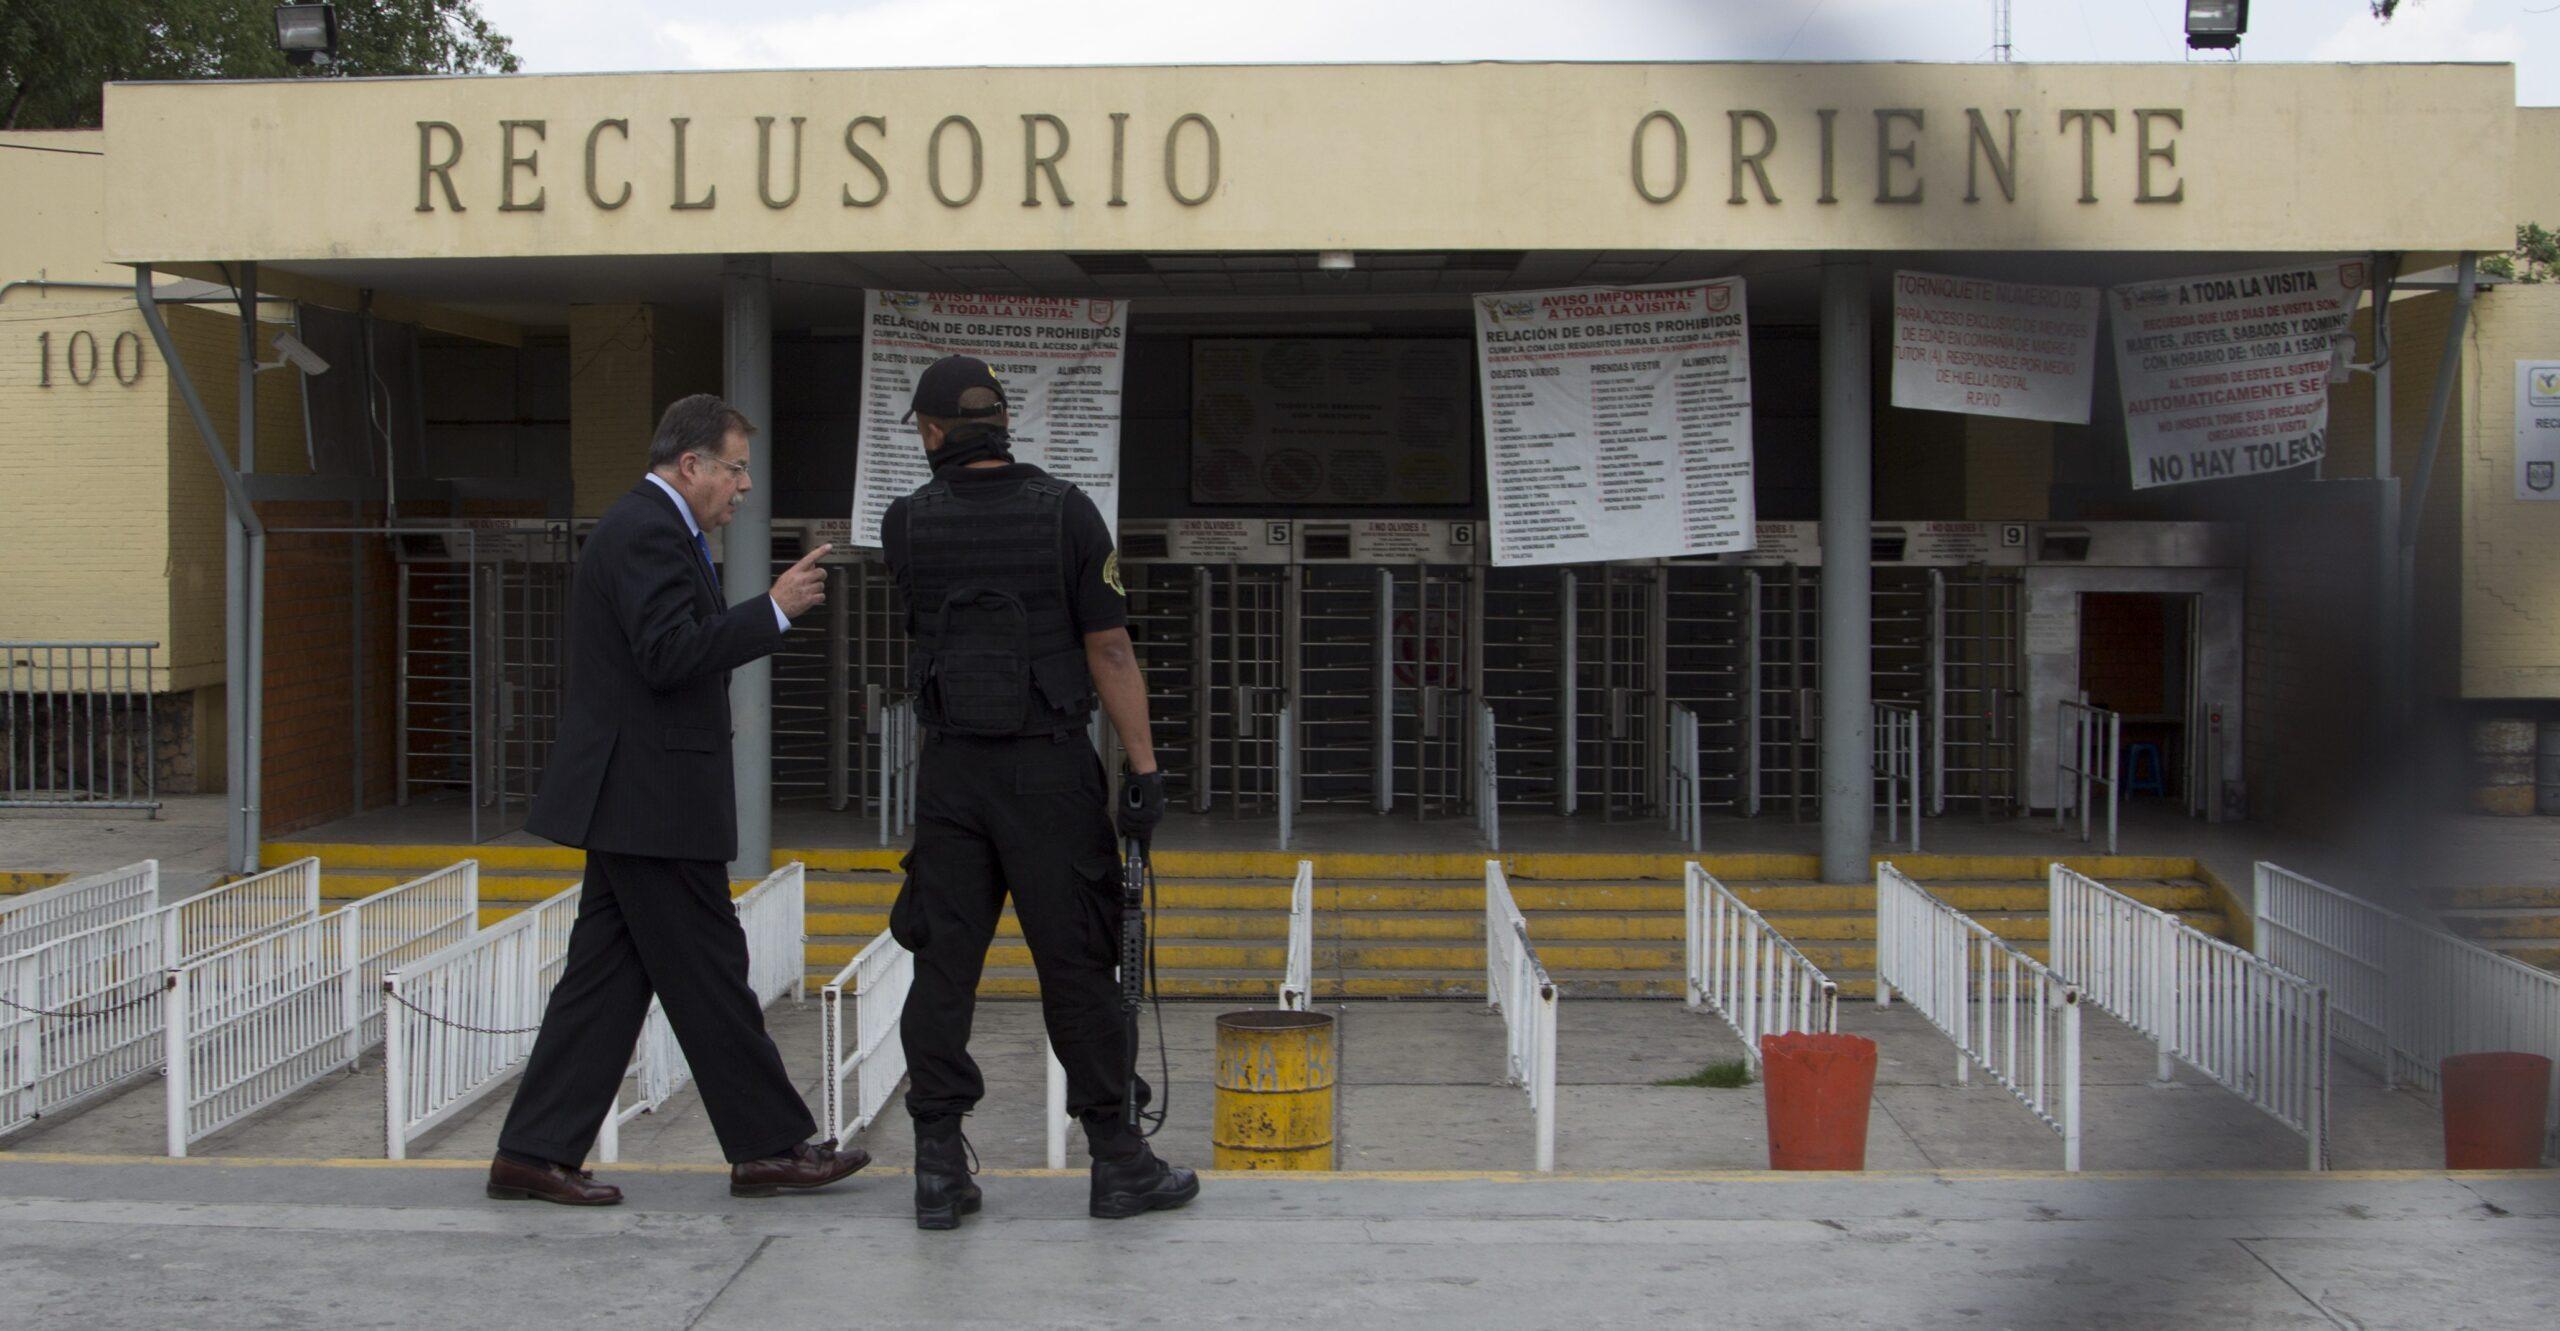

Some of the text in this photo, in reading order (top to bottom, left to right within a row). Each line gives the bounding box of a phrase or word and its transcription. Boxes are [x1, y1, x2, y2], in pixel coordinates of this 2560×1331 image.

[414, 107, 2185, 212] RECLUSORIO ORIENTE
[1541, 293, 1588, 308] AVISO
[1593, 288, 1696, 304] IMPORTANTE
[1897, 275, 1994, 300] TORNIQUETE
[2063, 291, 2081, 310] 09
[2179, 285, 2190, 305] A
[2193, 279, 2237, 303] TODA
[2240, 277, 2262, 298] LA
[2263, 270, 2318, 296] VISITA
[927, 291, 974, 303] AVISO
[979, 293, 1080, 307] IMPORTANTE
[1548, 308, 1559, 320] A
[1564, 305, 1607, 318] TODA
[1611, 303, 1631, 316] LA
[1633, 300, 1692, 314] VISITA:
[931, 303, 1073, 319] A TODA LA VISITA:
[1895, 306, 2089, 338] PARA ACCESO EXCLUSIVO DE MENORES
[2197, 312, 2217, 325] QUE
[2220, 309, 2240, 321] LOS
[2266, 305, 2280, 318] DE
[2283, 301, 2314, 316] VISITA
[944, 322, 962, 334] DE
[967, 323, 1032, 337] OBJETOS
[1486, 313, 1743, 343] RELACIÓN DE OBJETOS PROHIBIDOS
[2290, 320, 2299, 331] Y
[872, 329, 908, 340] CUMPLA
[929, 336, 947, 344] LOS
[949, 337, 1002, 348] REQUISITOS
[1004, 340, 1027, 349] PARA
[1029, 341, 1040, 349] EL
[1043, 341, 1078, 351] ACCESO
[1488, 329, 1743, 355] CUMPLA CON LOS REQUISITOS PARA EL ACCESO AL PENAL
[1902, 326, 1916, 341] DE
[1918, 328, 1946, 343] EDAD
[1947, 330, 1961, 345] EN
[2016, 337, 2030, 352] DE
[2031, 338, 2068, 355] MADRE
[38, 330, 145, 388] 100
[871, 352, 908, 364] OBJETOS
[1681, 355, 1728, 368] ALIMENTOS
[1893, 345, 1926, 361] TUTOR
[1946, 350, 2018, 371] RESPONSABLE
[2020, 356, 2040, 372] POR
[2042, 359, 2077, 376] MEDIO
[2142, 355, 2168, 370] CON
[2170, 348, 2226, 367] HORARIO
[2250, 341, 2280, 358] 10:00
[2283, 341, 2292, 354] A
[2295, 336, 2327, 353] 15:00
[1008, 364, 1038, 375] VESTIR
[1056, 365, 1103, 376] ALIMENTOS
[1490, 366, 1560, 379] OBJETOS VARIOS
[1590, 360, 1661, 374] PRENDAS VESTIR
[2169, 378, 2183, 390] AL
[2230, 370, 2244, 383] DE
[2246, 367, 2272, 381] ESTE
[2274, 365, 2286, 378] EL
[1936, 368, 2029, 391] DE HUELLA DIGITAL
[2127, 377, 2319, 414] AUTOMATICAMENTE SE
[2158, 420, 2173, 432] NO
[2174, 416, 2213, 431] INSISTA
[2215, 413, 2243, 427] TOME
[2246, 410, 2266, 424] SUS
[2207, 418, 2307, 442] ORGANICE SU VISITA
[2149, 454, 2184, 483] NO
[2190, 446, 2237, 479] HAY
[1271, 525, 1287, 542] 5
[1455, 526, 1470, 542] 6
[2007, 527, 2021, 544] 9
